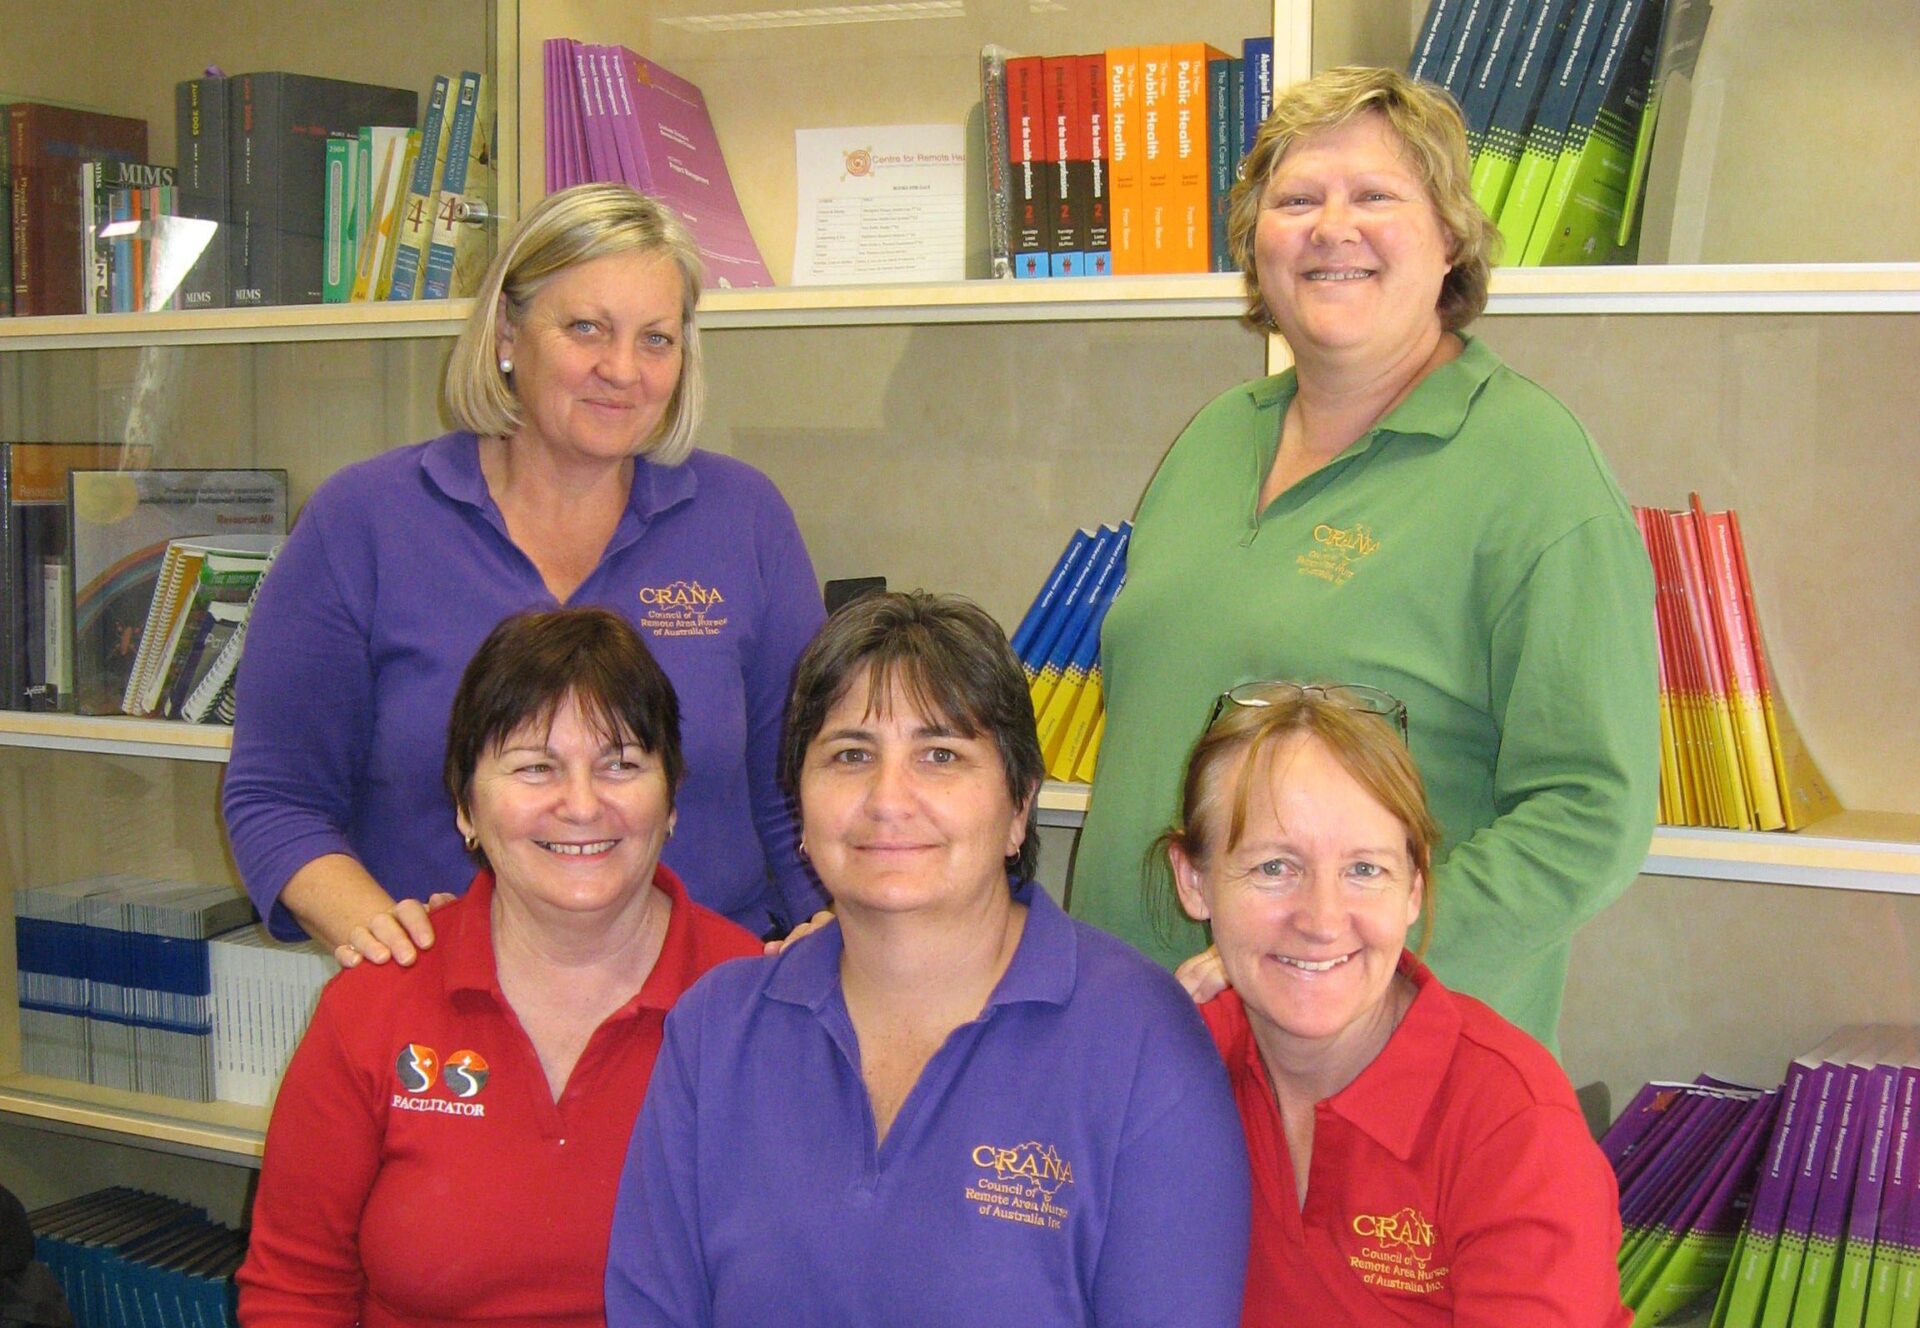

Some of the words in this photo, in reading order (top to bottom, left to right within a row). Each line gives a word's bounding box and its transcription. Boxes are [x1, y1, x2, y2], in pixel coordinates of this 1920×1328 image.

[1465, 9, 1476, 30] Allied
[1501, 6, 1512, 28] Allied
[1537, 4, 1549, 26] Allied
[1582, 2, 1594, 24] Allied
[1422, 33, 1435, 56] Health
[1457, 31, 1470, 54] Health
[1492, 28, 1505, 52] Health
[1529, 26, 1541, 50] Health
[1573, 25, 1586, 49] Health
[1611, 23, 1624, 47] Health
[1127, 64, 1135, 78] The
[1160, 62, 1168, 76] The
[1193, 61, 1201, 75] The
[1258, 53, 1270, 94] Aboriginal
[1413, 56, 1426, 84] Practic
[1446, 55, 1460, 84] Practice
[1481, 52, 1496, 82] Practice
[1518, 51, 1532, 81] Practice
[1562, 50, 1578, 80] Practice
[1600, 48, 1616, 78] Practice
[1113, 65, 1125, 108] Public
[1146, 63, 1158, 106] Public
[1178, 61, 1190, 104] Public
[1218, 72, 1226, 84] The
[1218, 86, 1226, 120] Australian
[192, 110, 200, 136] 2005
[1022, 117, 1031, 126] for
[1058, 116, 1067, 126] for
[1092, 114, 1100, 124] for
[1092, 125, 1101, 136] the
[1022, 126, 1031, 138] the
[1058, 126, 1067, 138] the
[1114, 112, 1126, 161] Health
[1146, 111, 1158, 160] Health
[1179, 110, 1192, 158] Health
[1218, 121, 1227, 146] Health
[872, 155, 900, 164] Centre
[903, 154, 914, 162] for
[917, 153, 950, 162] Remote
[1023, 139, 1032, 160] health
[1059, 138, 1068, 160] health
[1093, 136, 1102, 159] health
[120, 162, 173, 187] MIMS
[1022, 160, 1033, 200] professions
[1058, 160, 1069, 200] professions
[1092, 159, 1103, 198] professions
[1218, 166, 1228, 190] System
[407, 200, 423, 232] 4
[439, 198, 457, 231] 4
[1025, 204, 1034, 218] 2
[1060, 204, 1069, 218] 2
[1094, 202, 1103, 217] 2
[186, 291, 212, 302] MIMS
[235, 288, 261, 300] MIMS
[640, 587, 725, 604] CRANA
[640, 618, 674, 628] Remote
[676, 620, 697, 628] Area
[648, 610, 682, 619] Council
[653, 628, 662, 636] of
[664, 628, 704, 636] Australia
[1791, 1073, 1803, 1101] Remote
[1822, 1071, 1834, 1099] Remote
[1846, 1073, 1859, 1102] Remote
[1882, 1074, 1893, 1104] Remote
[1905, 1076, 1916, 1105] Remote
[392, 1094, 485, 1117] FACILITATOR
[1784, 1102, 1796, 1126] Health
[1816, 1100, 1828, 1124] Health
[1841, 1102, 1853, 1126] Health
[1878, 1104, 1888, 1128] Health
[1902, 1106, 1912, 1130] Health
[1773, 1126, 1790, 1171] Management
[1805, 1124, 1822, 1170] Management
[1832, 1127, 1847, 1173] Management
[1870, 1130, 1884, 1176] Management
[1895, 1132, 1908, 1178] Management
[972, 1146, 1074, 1184] CRANA
[965, 1188, 1010, 1205] Remote
[1012, 1196, 1039, 1212] Area
[978, 1178, 1022, 1196] Council
[1025, 1188, 1038, 1198] of
[979, 1205, 992, 1216] of
[992, 1206, 1045, 1226] Australia
[1350, 1256, 1391, 1274] Remote
[1393, 1265, 1416, 1280] Area
[1362, 1248, 1402, 1264] Council
[1363, 1273, 1376, 1285] of
[1376, 1276, 1425, 1294] Australia
